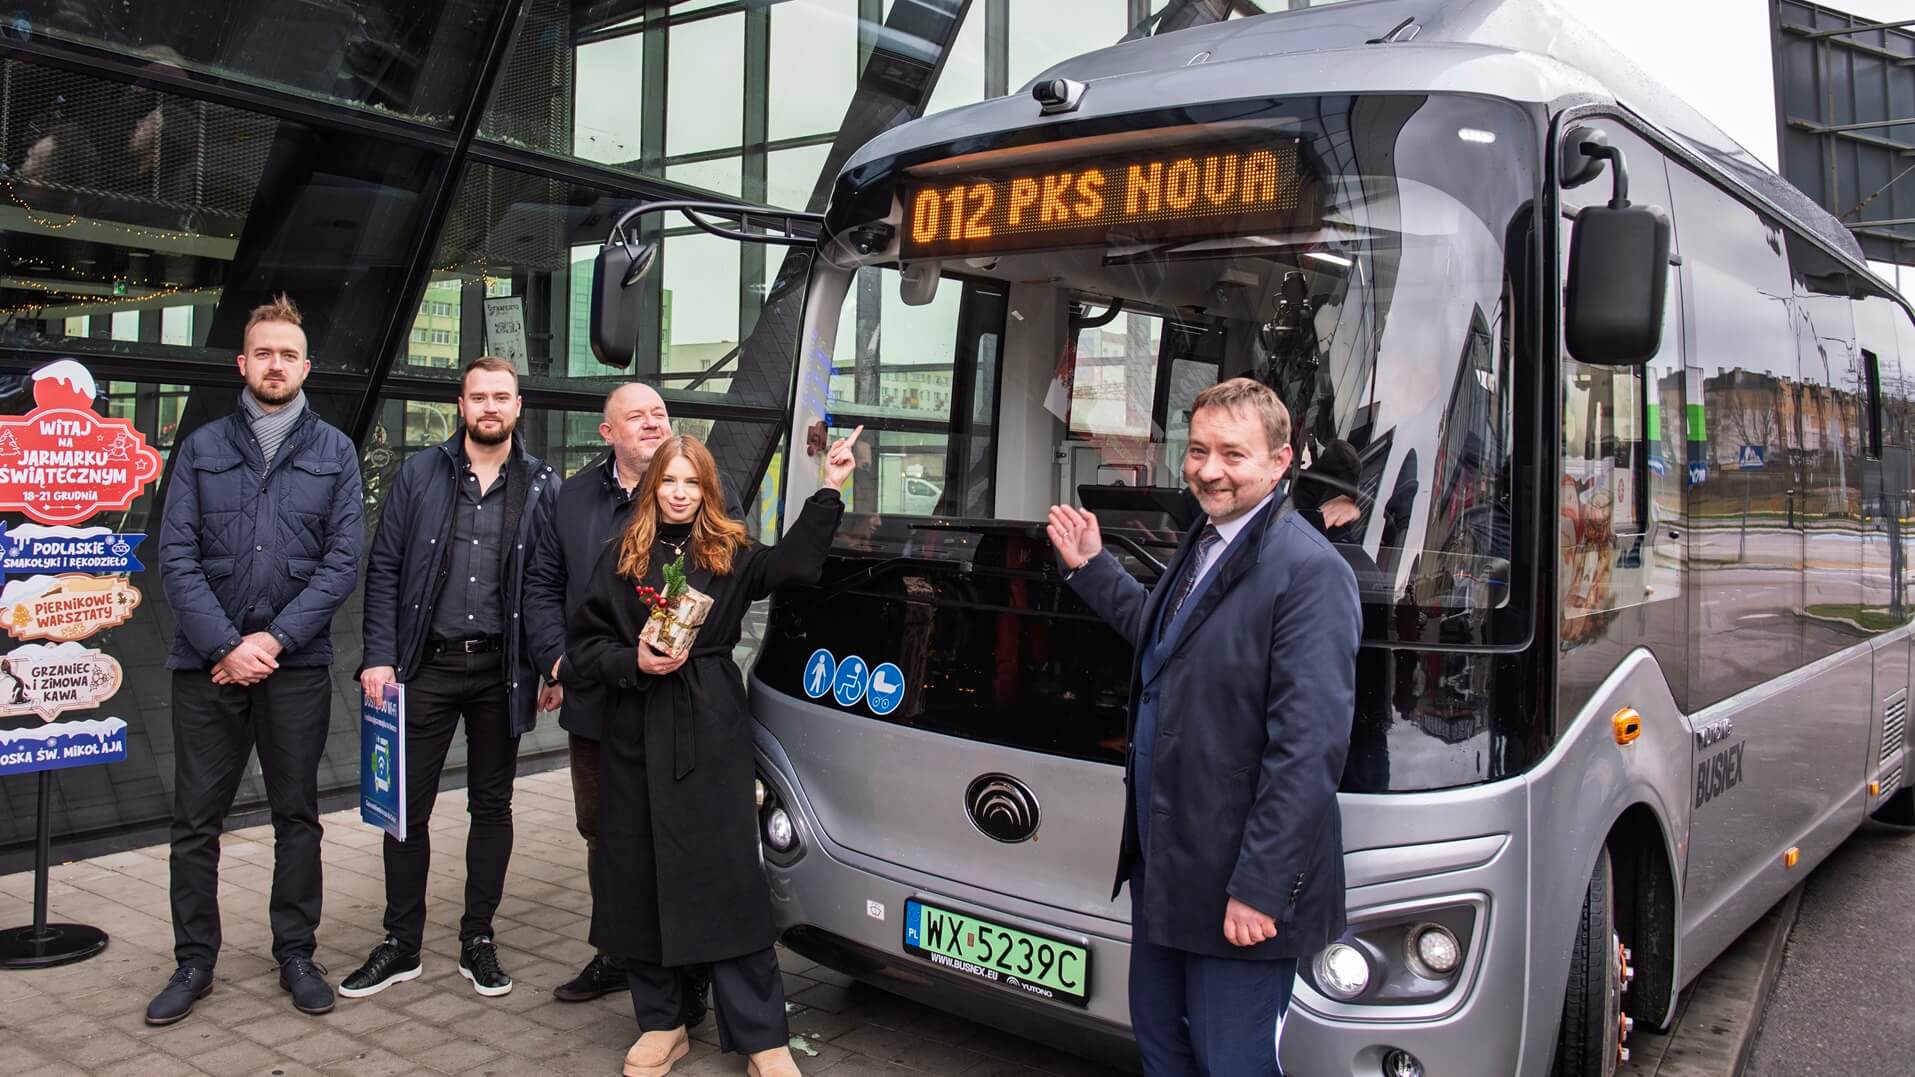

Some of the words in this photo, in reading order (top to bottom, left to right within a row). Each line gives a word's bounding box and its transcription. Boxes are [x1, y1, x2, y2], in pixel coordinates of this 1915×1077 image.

[912, 182, 995, 243] 012
[1008, 169, 1104, 224] PKS
[1126, 150, 1278, 214] NOVA
[40, 419, 91, 436] WITAJ
[58, 439, 72, 448] NA
[17, 451, 108, 466] JARMARKU
[23, 491, 50, 501] 18-21
[54, 490, 98, 501] GRUDNIA
[33, 541, 105, 555] PODLASKIE
[35, 592, 113, 615] PIERNIKOWE
[37, 606, 113, 628] WARSZTATY
[31, 663, 90, 678] GRZANIEC
[41, 675, 88, 690] ZIMOWA
[43, 688, 77, 703] KAWA
[36, 747, 61, 762] ŚW.
[1695, 740, 1745, 809] BUSNEX
[908, 928, 919, 940] PL
[927, 910, 965, 956] WX
[977, 925, 1078, 989] 5239C
[931, 951, 999, 981] WWW.BUSNEX.EU
[1021, 982, 1053, 998] YUTONG
